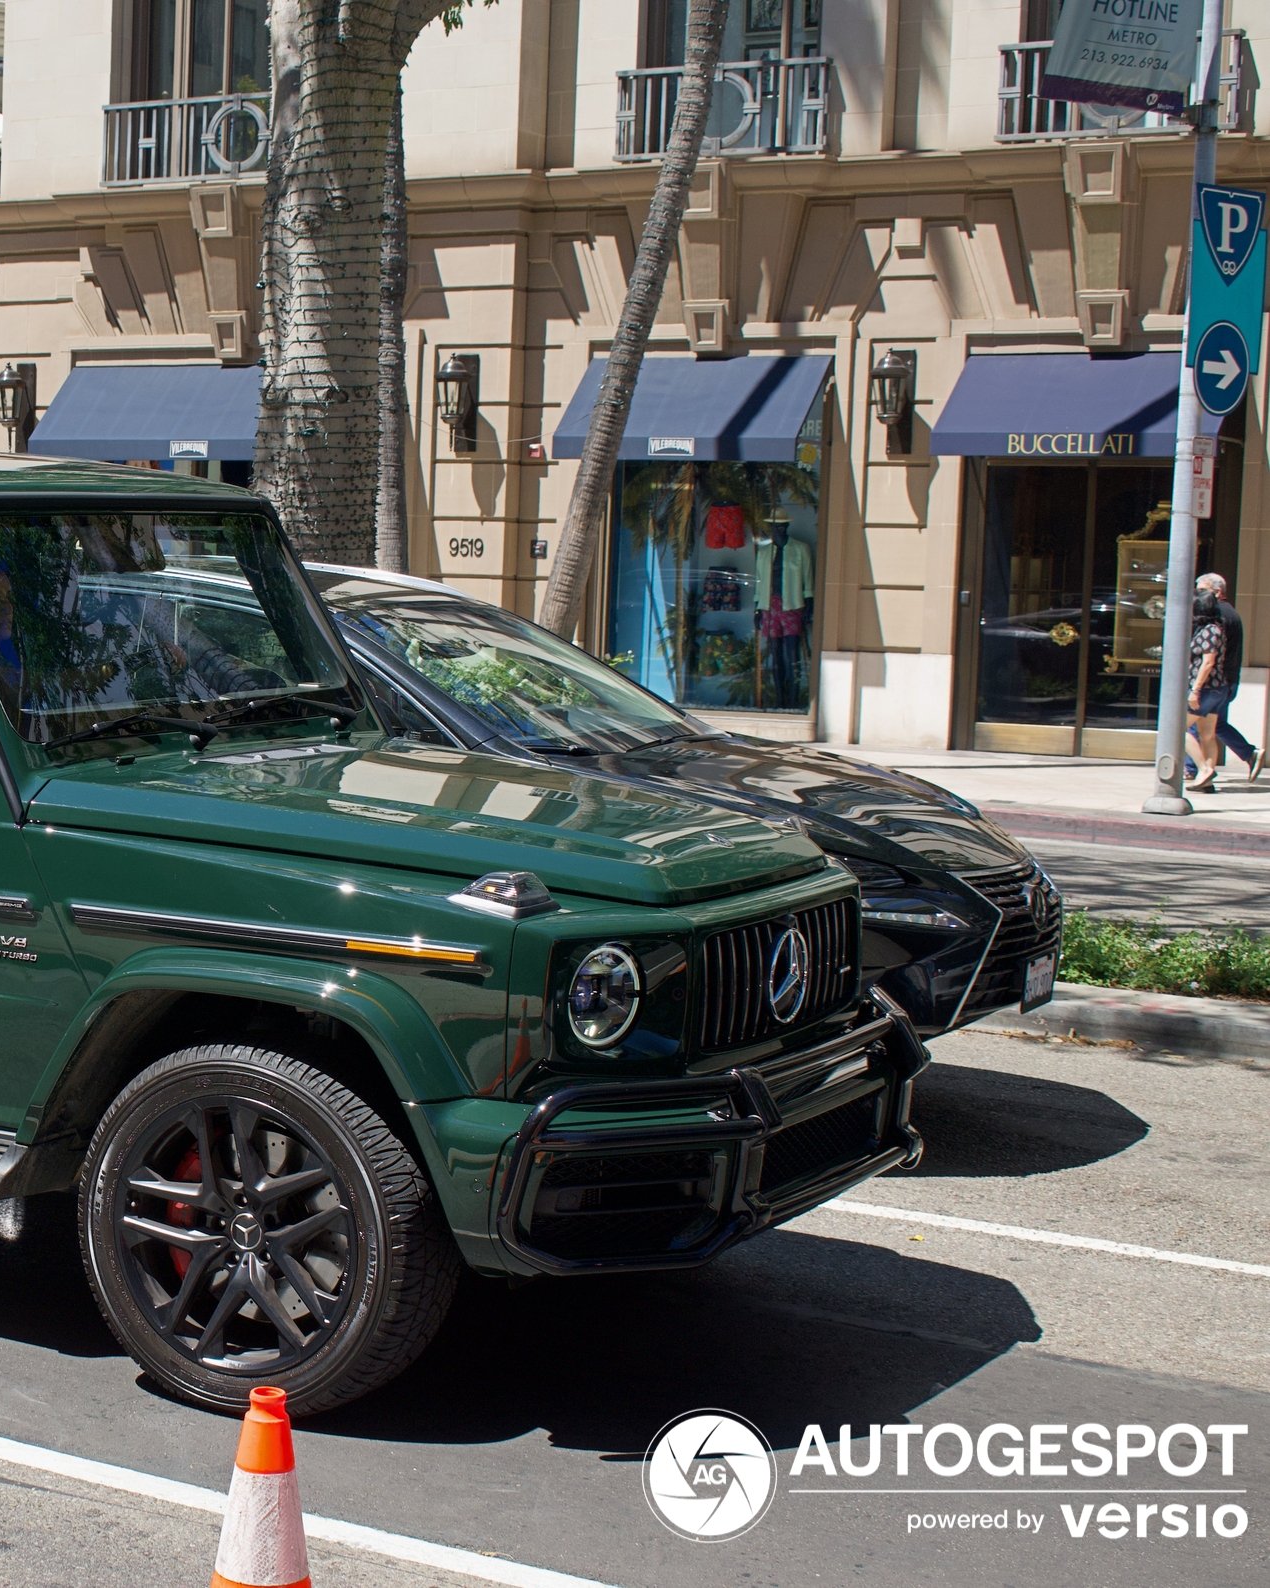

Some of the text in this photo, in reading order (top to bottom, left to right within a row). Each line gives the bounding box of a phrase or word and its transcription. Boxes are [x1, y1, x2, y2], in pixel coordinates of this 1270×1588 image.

[1092, 0, 1178, 23] HOTLINE
[1107, 29, 1157, 46] METRO
[1217, 202, 1249, 253] P
[171, 442, 206, 456] VILEBREQUIN
[650, 438, 693, 455] VILEBREQUIN
[1007, 433, 1134, 455] BUCCELLATI
[449, 538, 484, 558] 9519
[0, 935, 27, 948] V8
